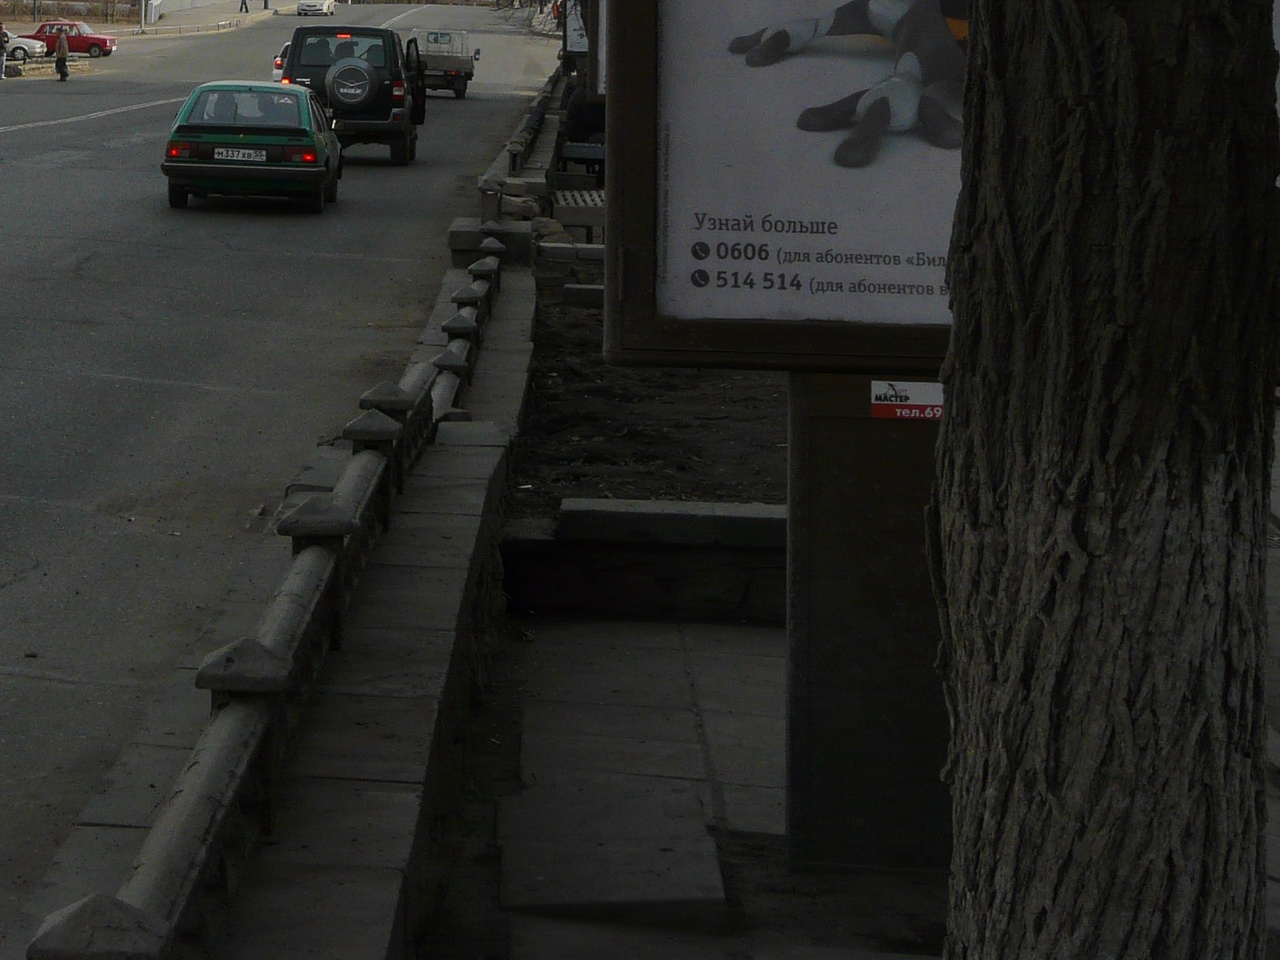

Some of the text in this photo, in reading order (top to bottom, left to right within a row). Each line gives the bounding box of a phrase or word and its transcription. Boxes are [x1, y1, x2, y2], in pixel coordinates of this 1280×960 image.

[694, 213, 838, 235] Узнай больше
[716, 242, 769, 260] 0606
[777, 247, 811, 264] (для
[815, 249, 901, 266] абонентов
[716, 270, 756, 289] 514
[763, 272, 802, 290] 514
[809, 277, 844, 294] (для
[848, 279, 934, 296] абонентов
